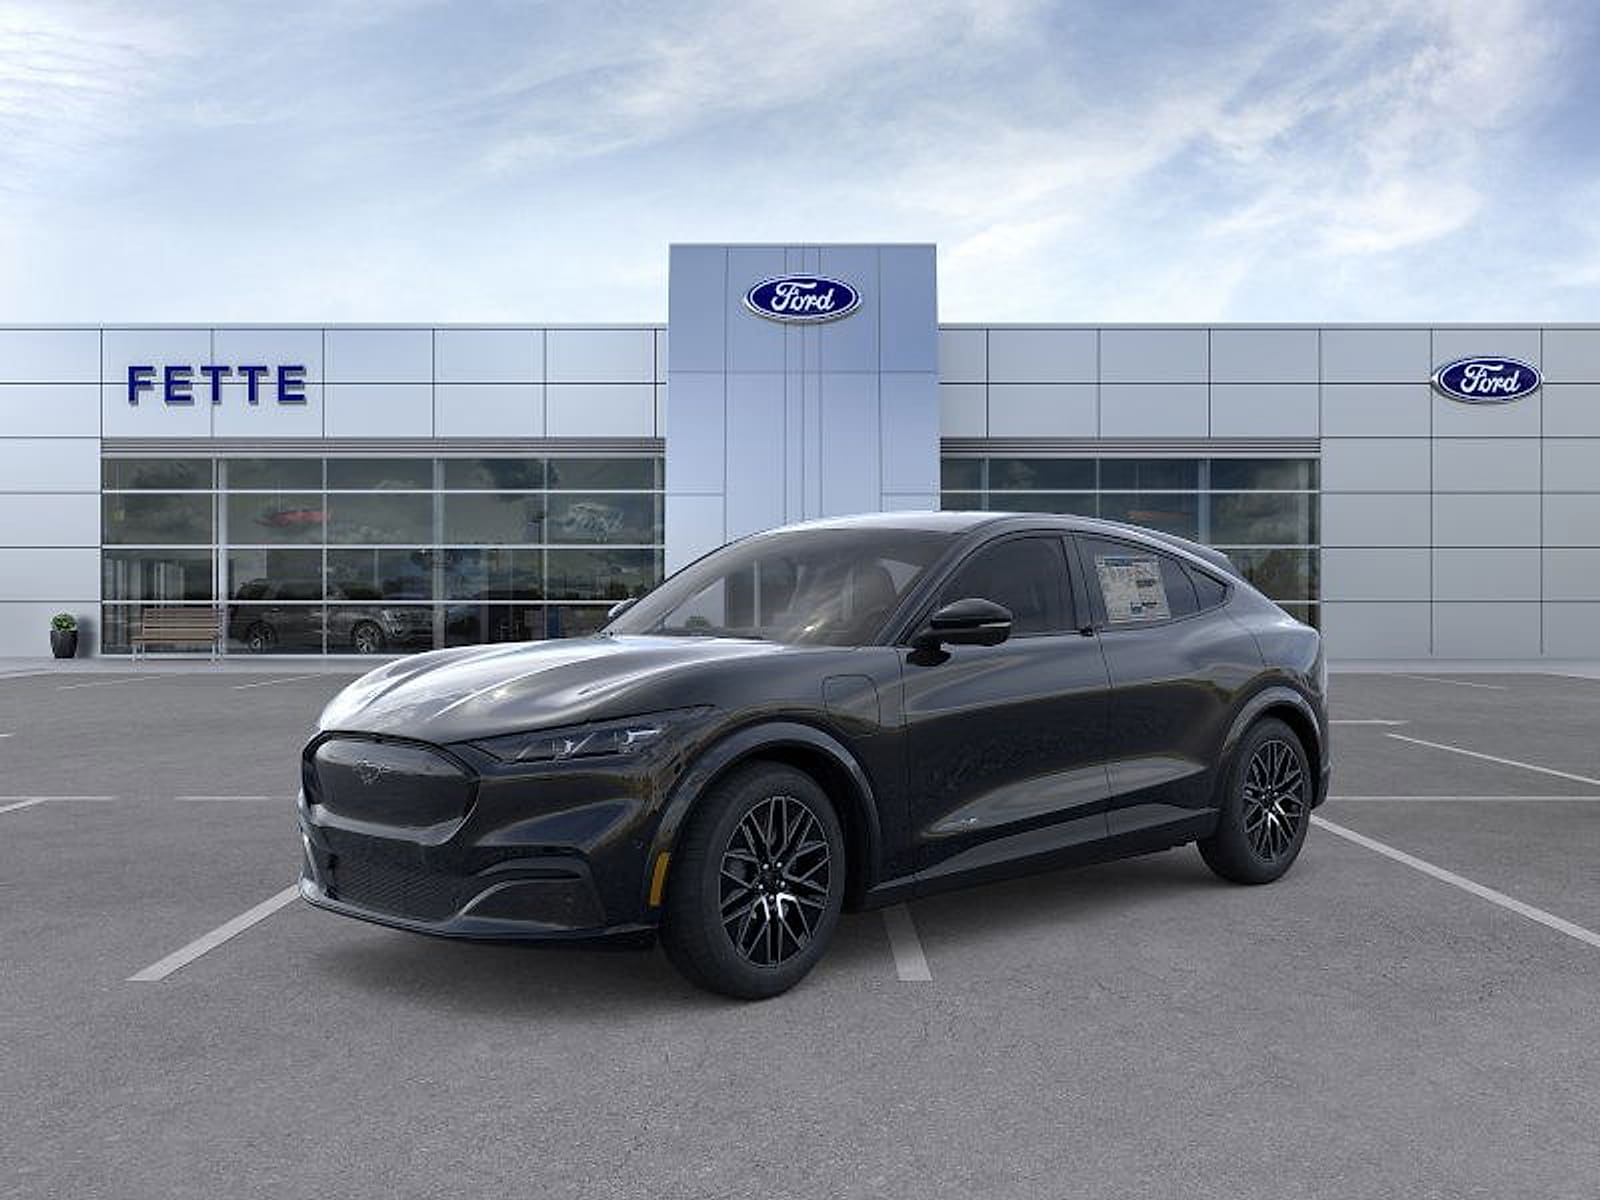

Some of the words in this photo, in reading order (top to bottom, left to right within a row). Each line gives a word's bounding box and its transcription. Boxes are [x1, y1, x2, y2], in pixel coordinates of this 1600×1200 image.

[771, 282, 835, 311] Ford
[128, 366, 306, 404] FETTE
[1461, 364, 1520, 393] Ford
